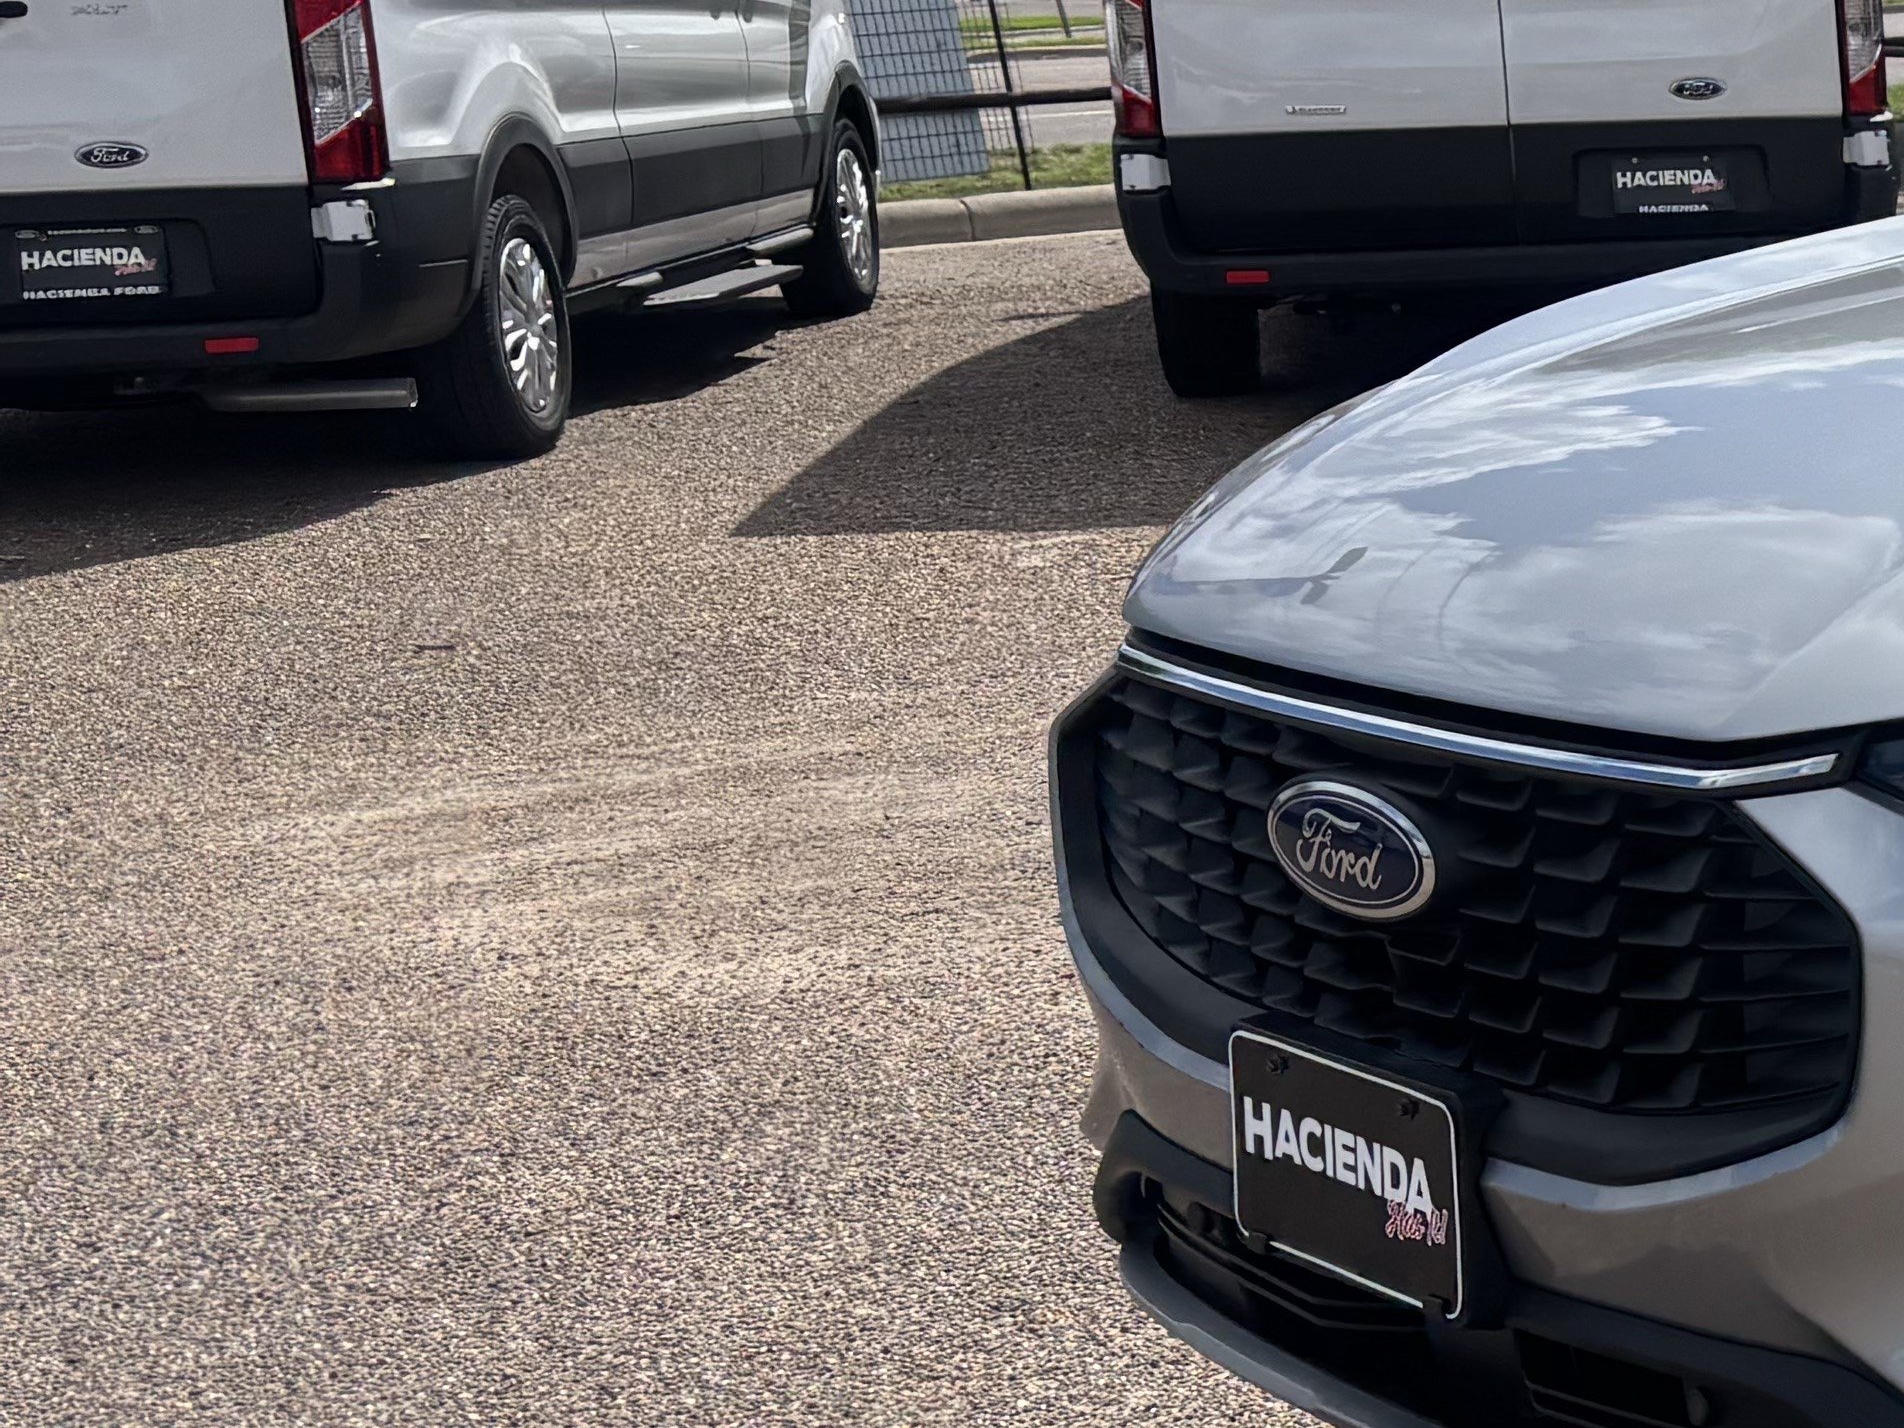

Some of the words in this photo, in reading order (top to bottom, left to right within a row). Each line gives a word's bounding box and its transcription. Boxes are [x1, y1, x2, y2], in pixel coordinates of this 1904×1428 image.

[1616, 169, 1717, 188] HACIENDA
[20, 246, 146, 270] HACIENDA
[1296, 807, 1383, 890] Ford
[1243, 1095, 1434, 1222] HACIENDA
